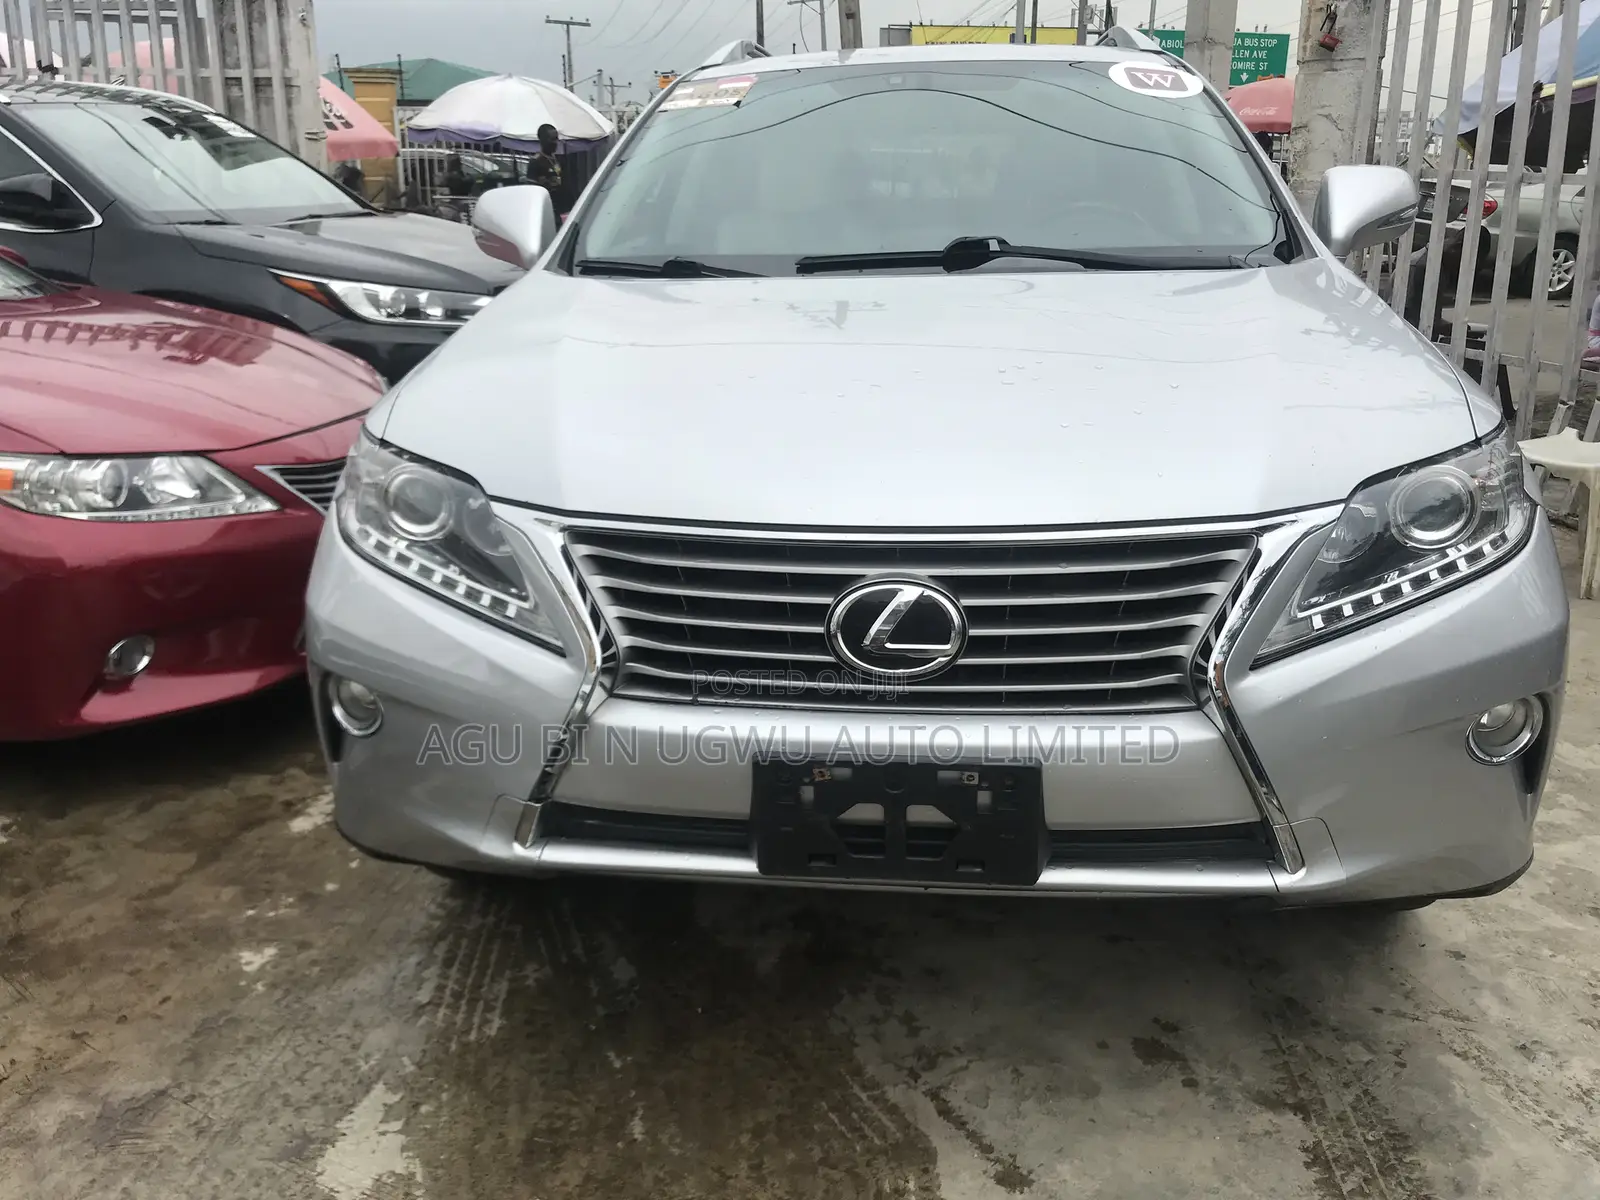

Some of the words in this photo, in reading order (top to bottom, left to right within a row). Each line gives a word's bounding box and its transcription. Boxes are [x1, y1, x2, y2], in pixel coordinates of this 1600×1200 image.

[1244, 38, 1259, 47] BUS
[1260, 38, 1278, 47] STOP
[1232, 49, 1250, 58] LEN
[1251, 50, 1268, 59] AVE
[1259, 62, 1269, 71] ST
